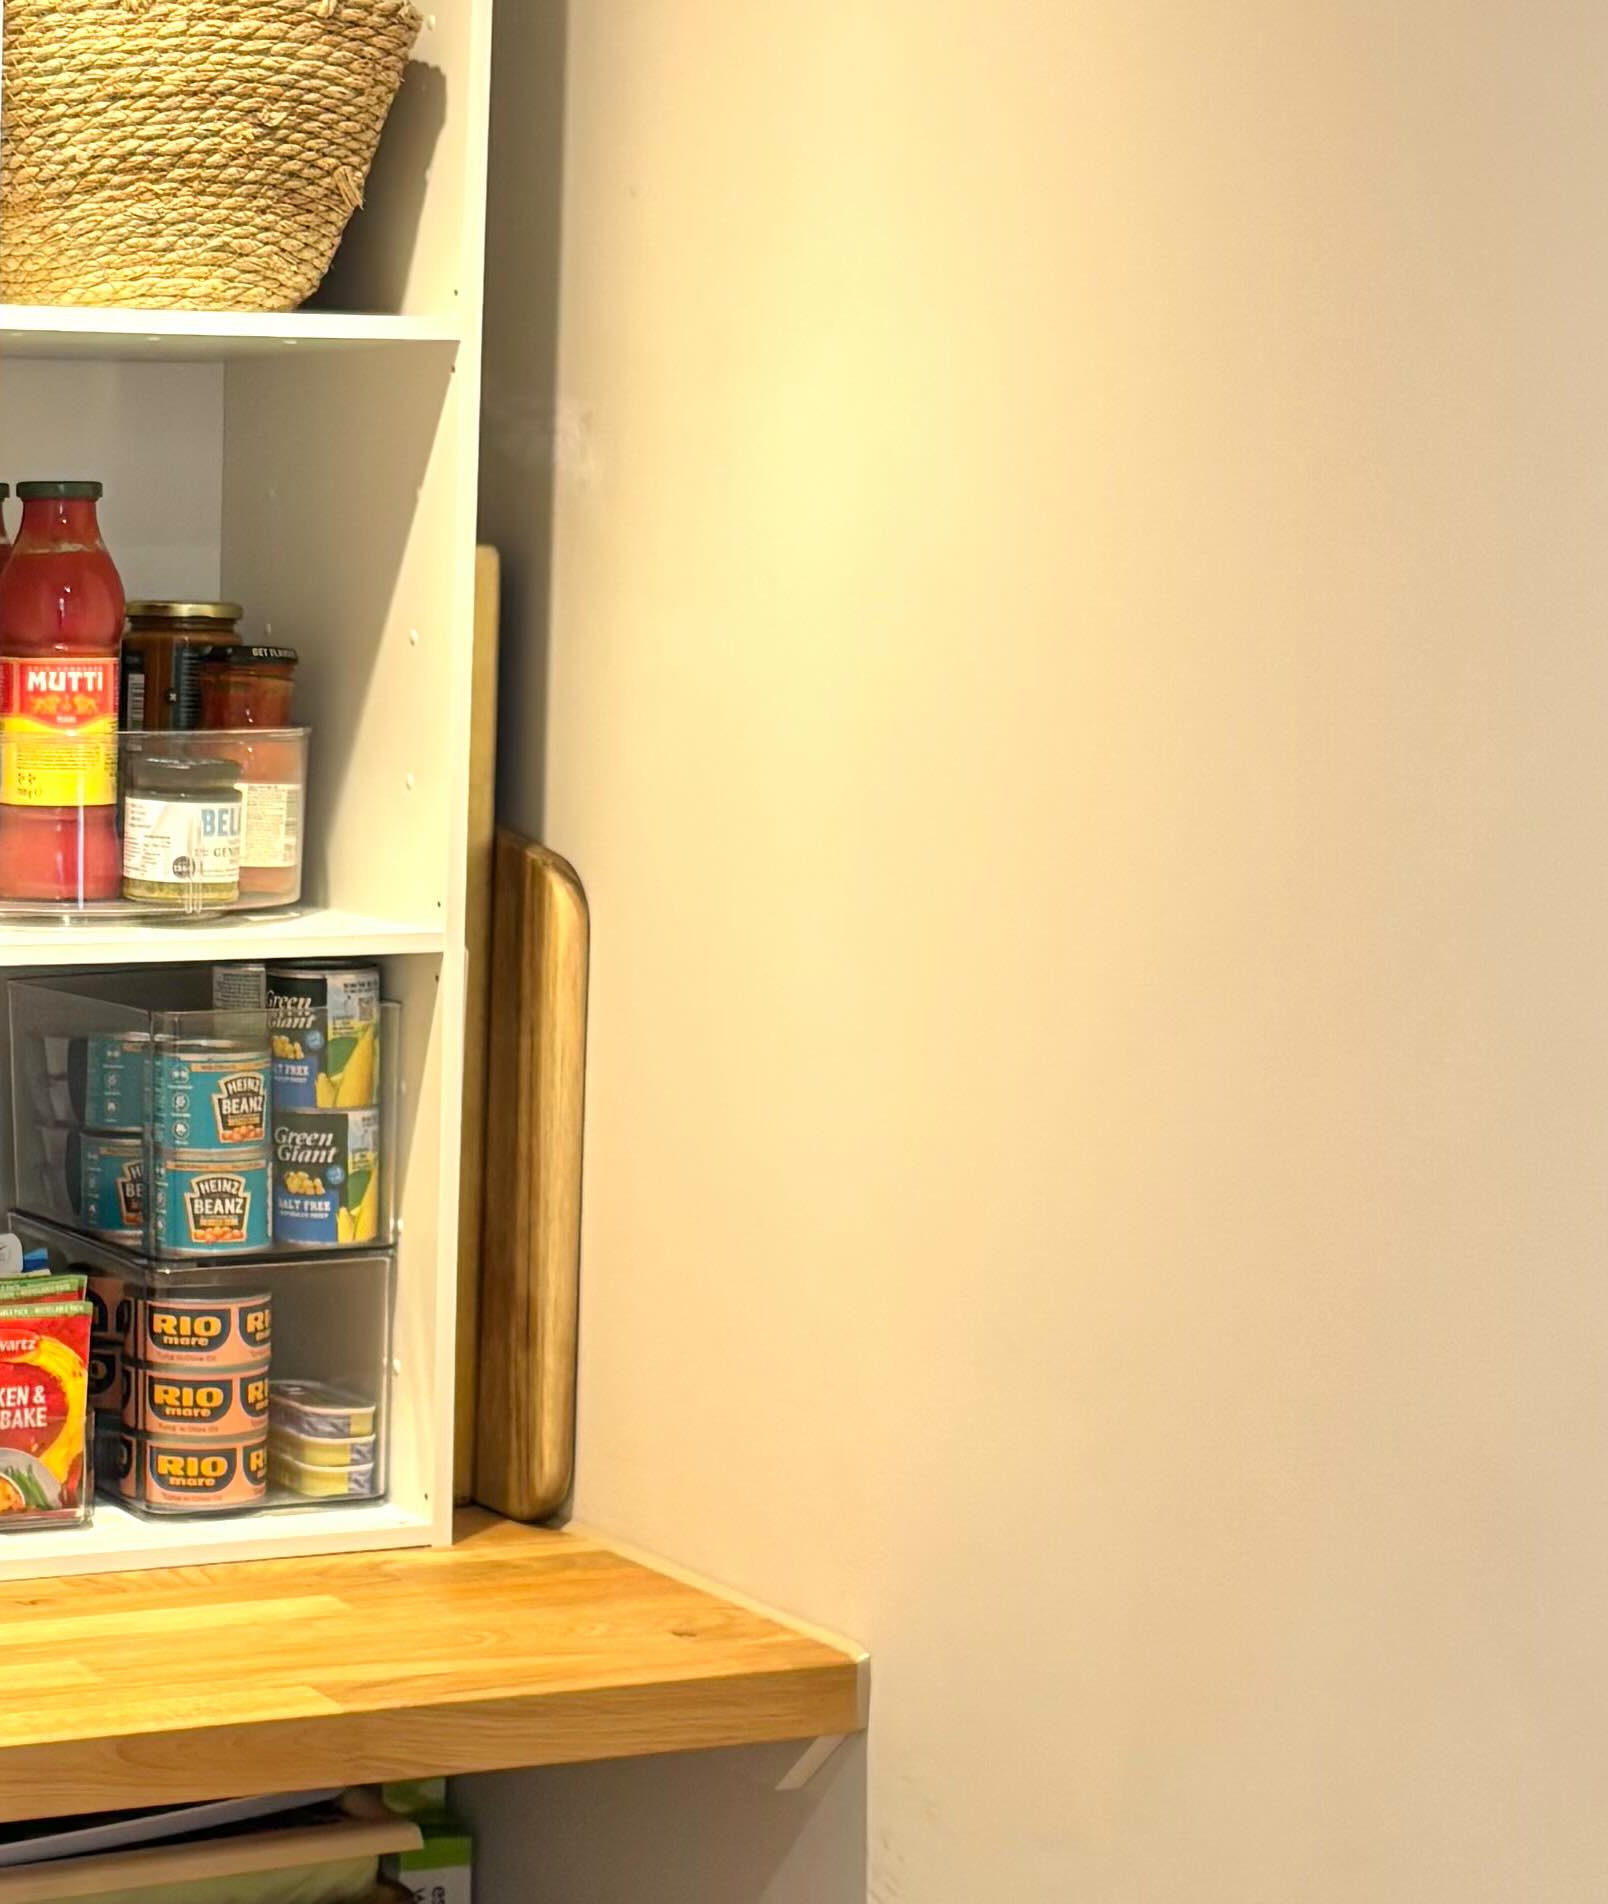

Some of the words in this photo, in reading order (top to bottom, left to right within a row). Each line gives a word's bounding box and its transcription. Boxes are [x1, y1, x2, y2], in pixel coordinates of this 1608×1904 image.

[27, 671, 104, 692] MUTTI
[226, 1076, 260, 1095] HEINZ
[221, 1097, 264, 1115] BEANZ
[274, 1126, 334, 1147] Green
[277, 1144, 337, 1164] Giant
[199, 1178, 240, 1195] HEINZ
[193, 1198, 245, 1215] BEANZ
[304, 1200, 331, 1212] FREE
[152, 1313, 222, 1337] RIO
[163, 1337, 209, 1347] mare
[32, 1385, 46, 1406] &
[154, 1384, 224, 1408] RIO
[0, 1407, 48, 1431] BAKE
[165, 1408, 212, 1418] mare
[157, 1454, 228, 1477] RIO
[168, 1477, 216, 1487] mare
